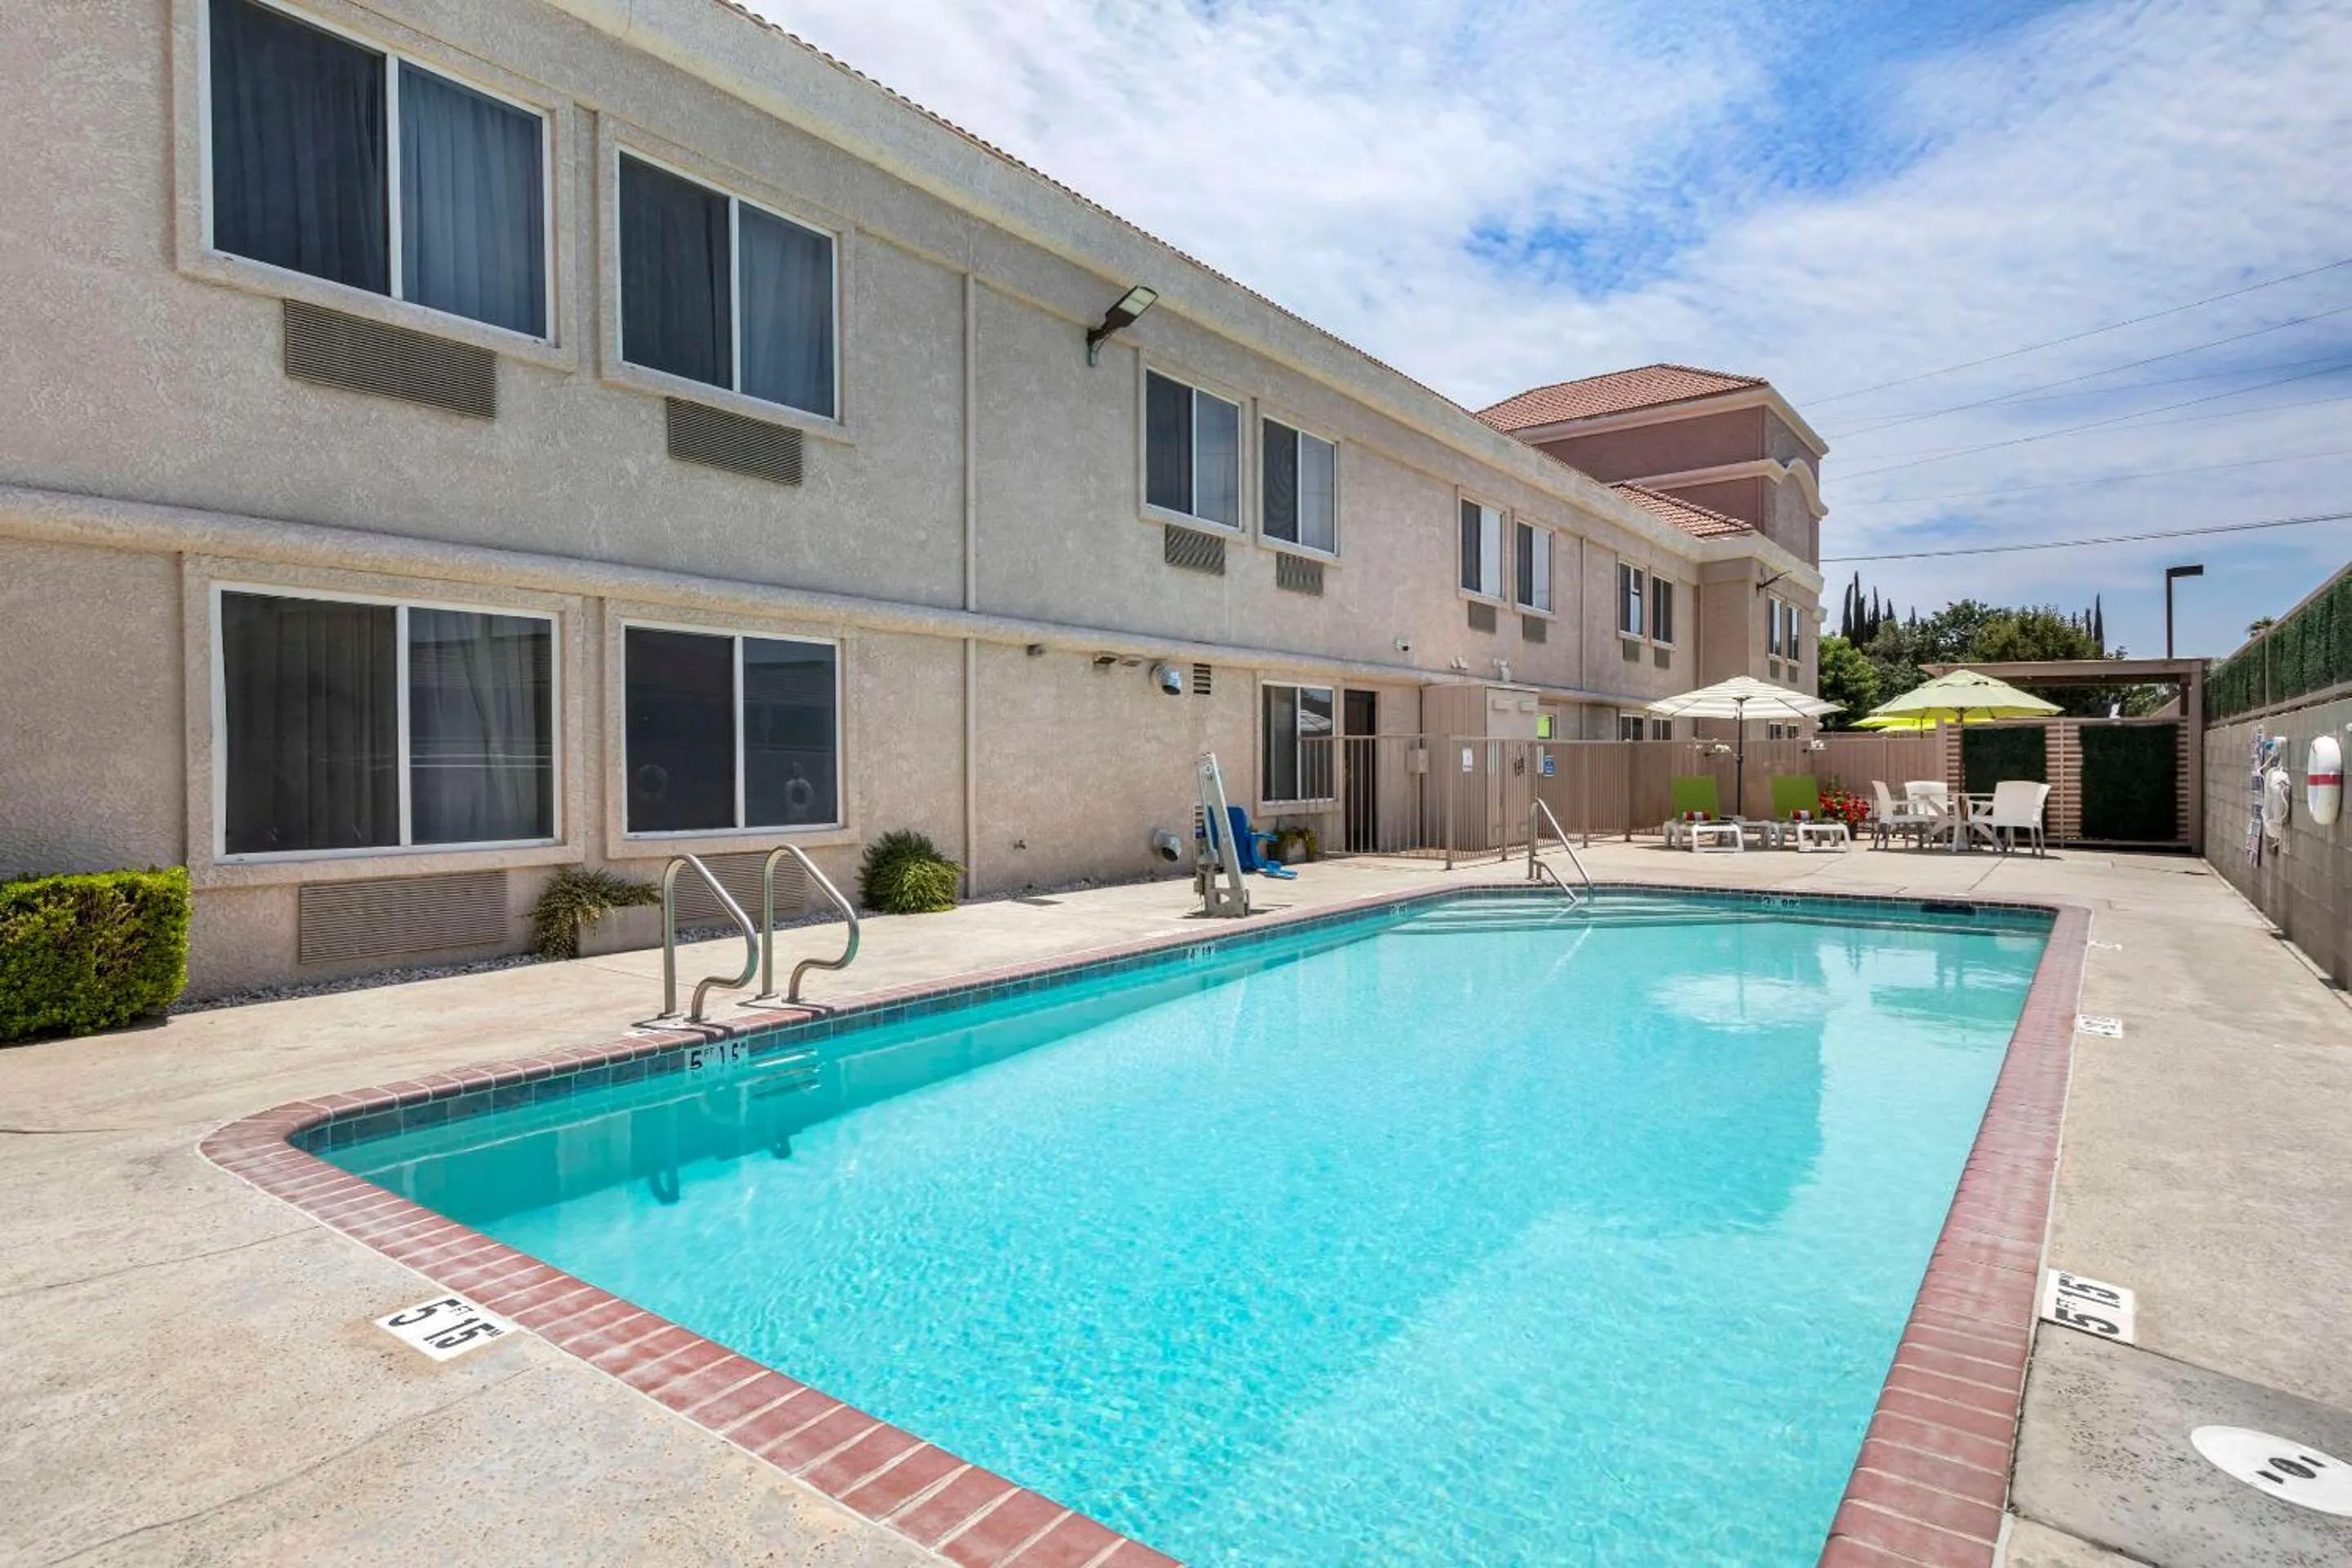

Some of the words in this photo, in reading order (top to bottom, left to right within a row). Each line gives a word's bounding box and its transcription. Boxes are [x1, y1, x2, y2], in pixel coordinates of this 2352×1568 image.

[689, 1050, 702, 1070] 5
[388, 1298, 462, 1327] 5
[2055, 1307, 2120, 1334] 5
